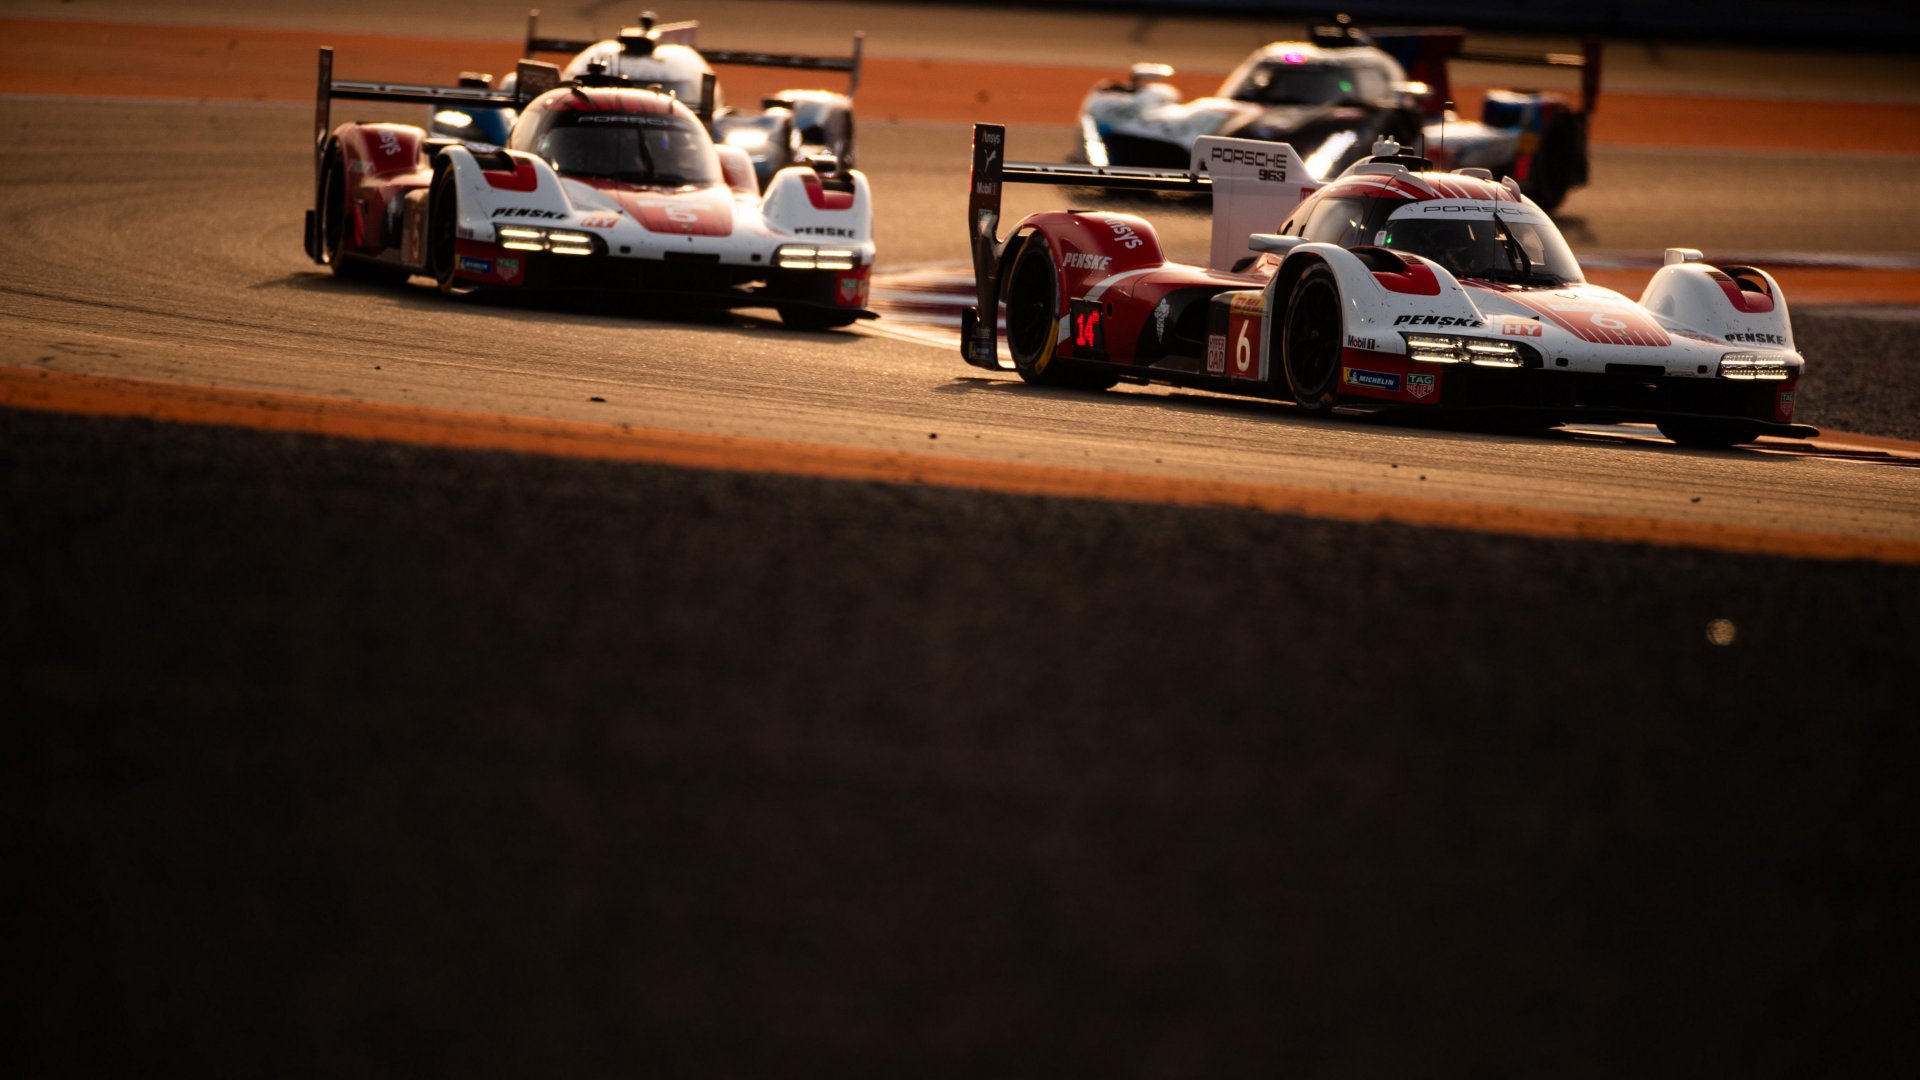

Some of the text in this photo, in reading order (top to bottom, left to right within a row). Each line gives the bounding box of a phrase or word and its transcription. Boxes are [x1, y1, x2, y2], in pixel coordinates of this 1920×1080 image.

[1211, 147, 1287, 169] PORSCHE
[1259, 169, 1286, 183] 963
[794, 227, 855, 239] PENSKE
[1062, 252, 1113, 270] PENSKE
[1393, 315, 1488, 329] PENSKE
[1590, 313, 1628, 330] 6
[1503, 323, 1541, 336] HY
[1236, 319, 1251, 372] 6
[1347, 335, 1376, 350] Mobil 1
[1725, 333, 1785, 346] PENSKE
[1208, 350, 1224, 370] CAR
[1358, 375, 1395, 386] MICHELIN
[1409, 375, 1432, 384] TAG
[1407, 384, 1434, 397] HEUER
